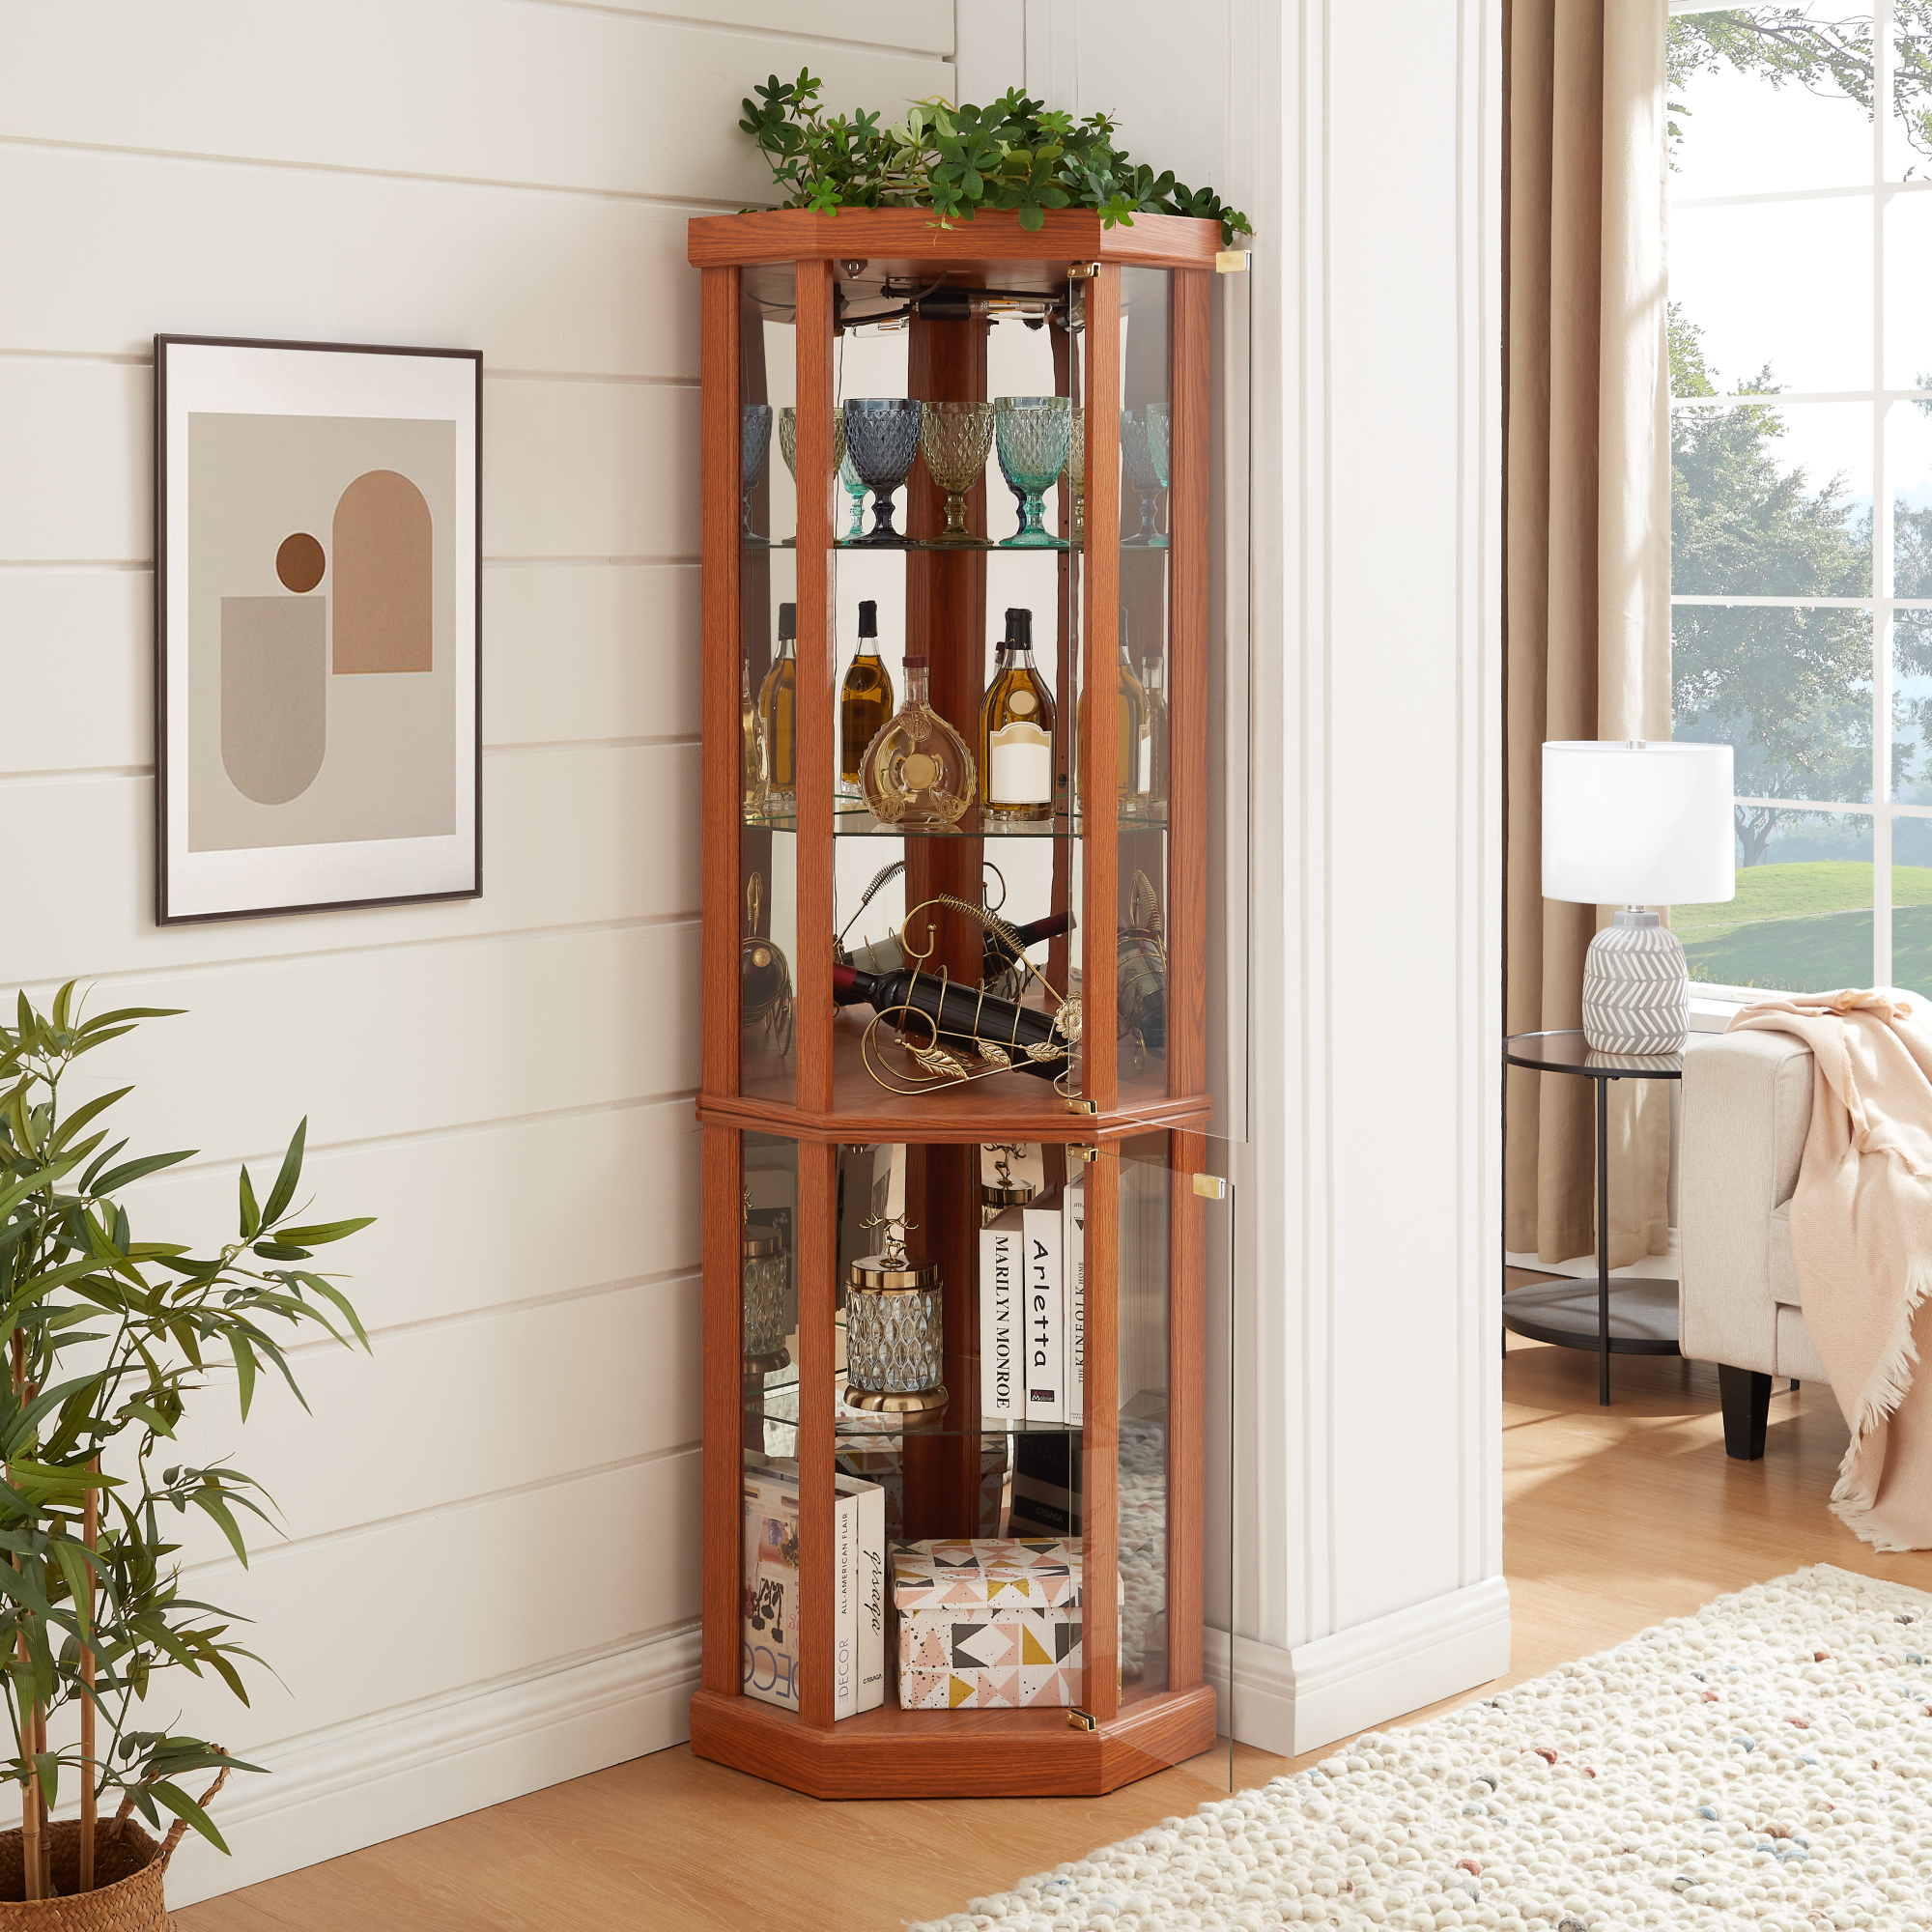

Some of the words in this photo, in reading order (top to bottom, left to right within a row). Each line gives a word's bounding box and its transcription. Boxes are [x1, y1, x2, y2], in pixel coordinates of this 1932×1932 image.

[995, 1236, 1009, 1322] MARILYN
[1033, 1238, 1050, 1368] Arletta
[996, 1327, 1010, 1408] MONROE
[838, 1637, 849, 1697] DECOR
